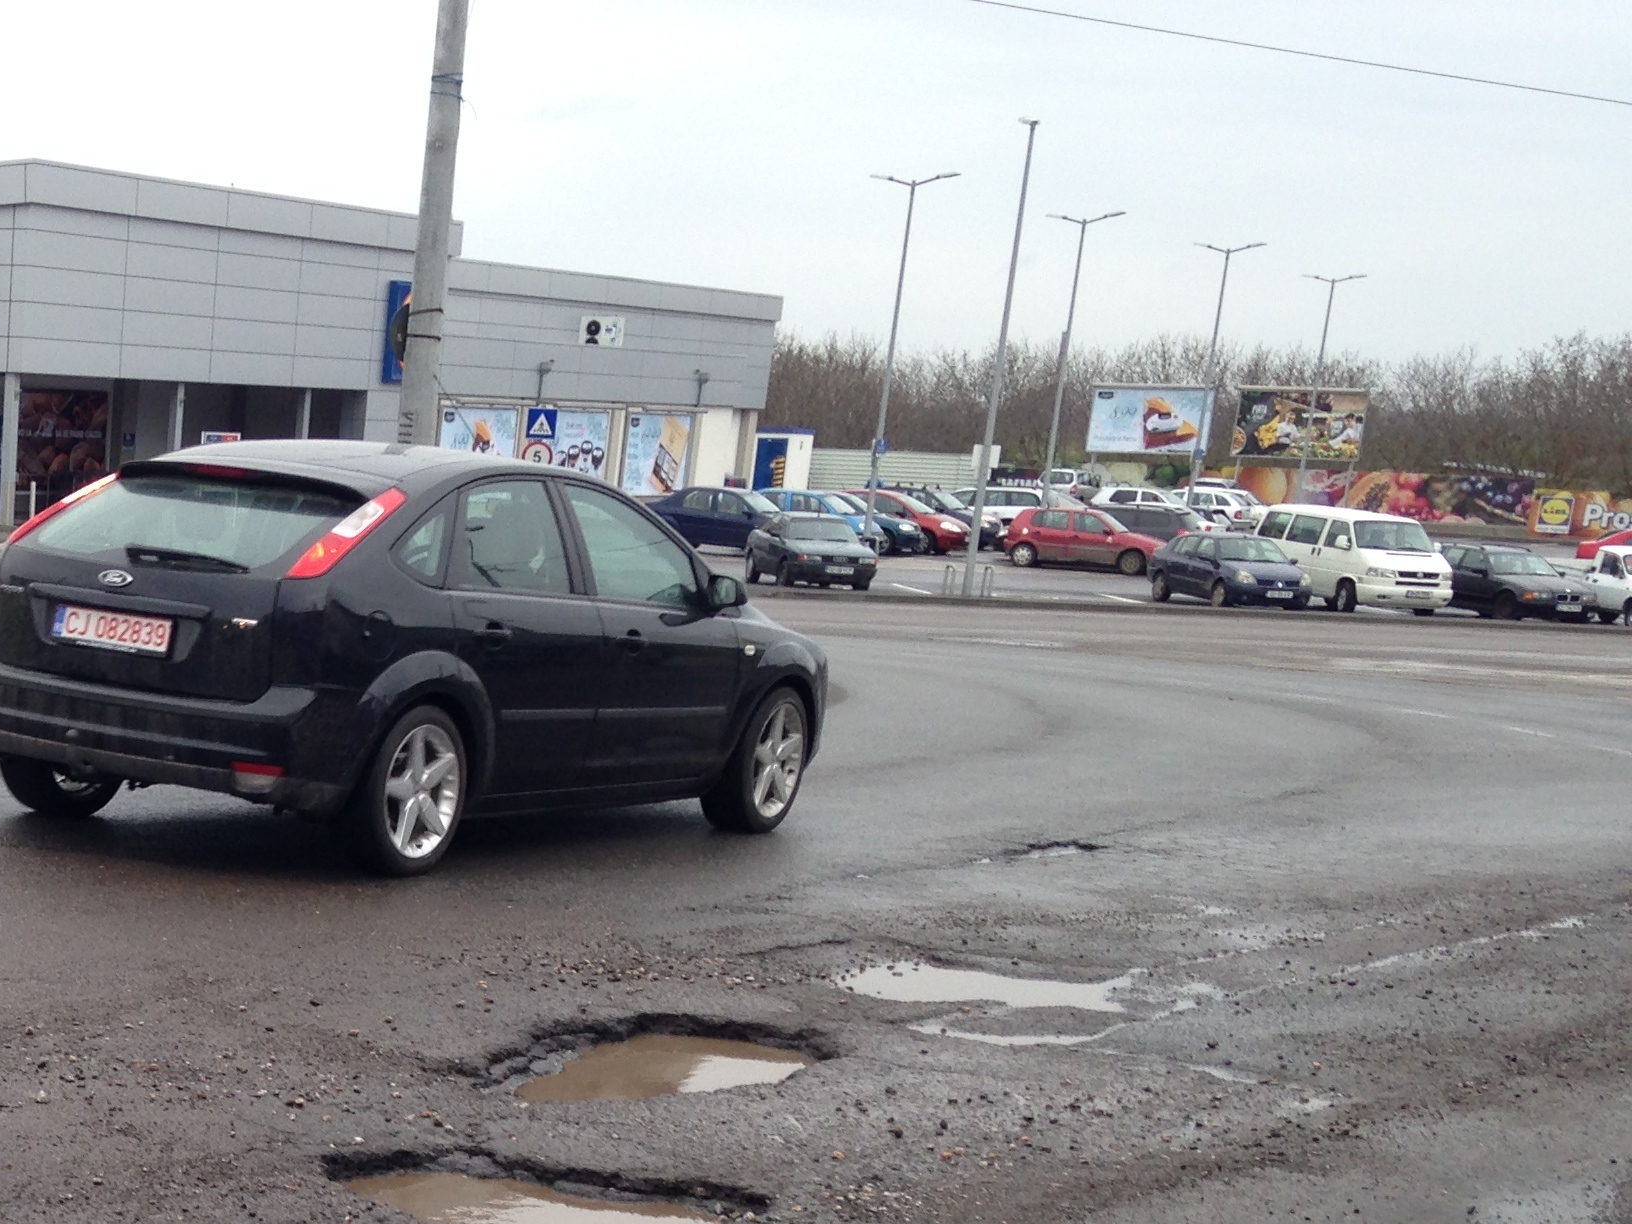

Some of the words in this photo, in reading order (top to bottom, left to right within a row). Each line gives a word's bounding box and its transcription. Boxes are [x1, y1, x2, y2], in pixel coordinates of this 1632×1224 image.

[532, 451, 542, 463] 5
[1582, 503, 1632, 530] Pro
[65, 610, 92, 636] CJ
[94, 614, 167, 647] 082839
